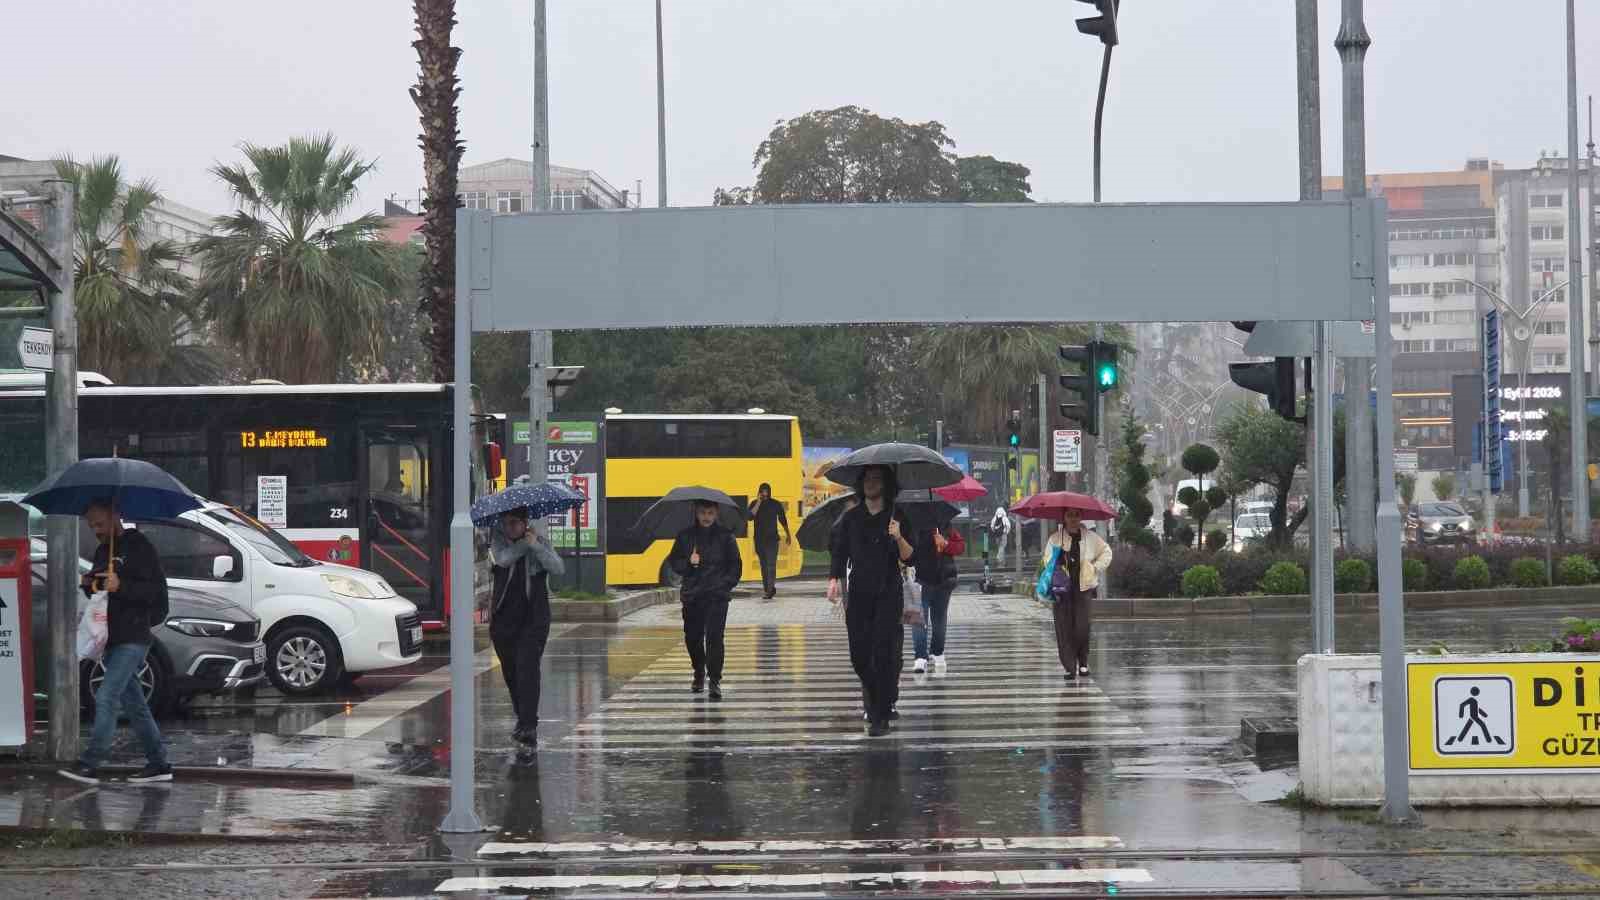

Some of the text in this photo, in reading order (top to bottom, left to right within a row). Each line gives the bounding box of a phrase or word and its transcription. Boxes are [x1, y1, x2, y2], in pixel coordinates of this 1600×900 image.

[1533, 386, 1562, 399] 2026
[329, 507, 349, 519] 234
[1533, 666, 1600, 707] Dİ
